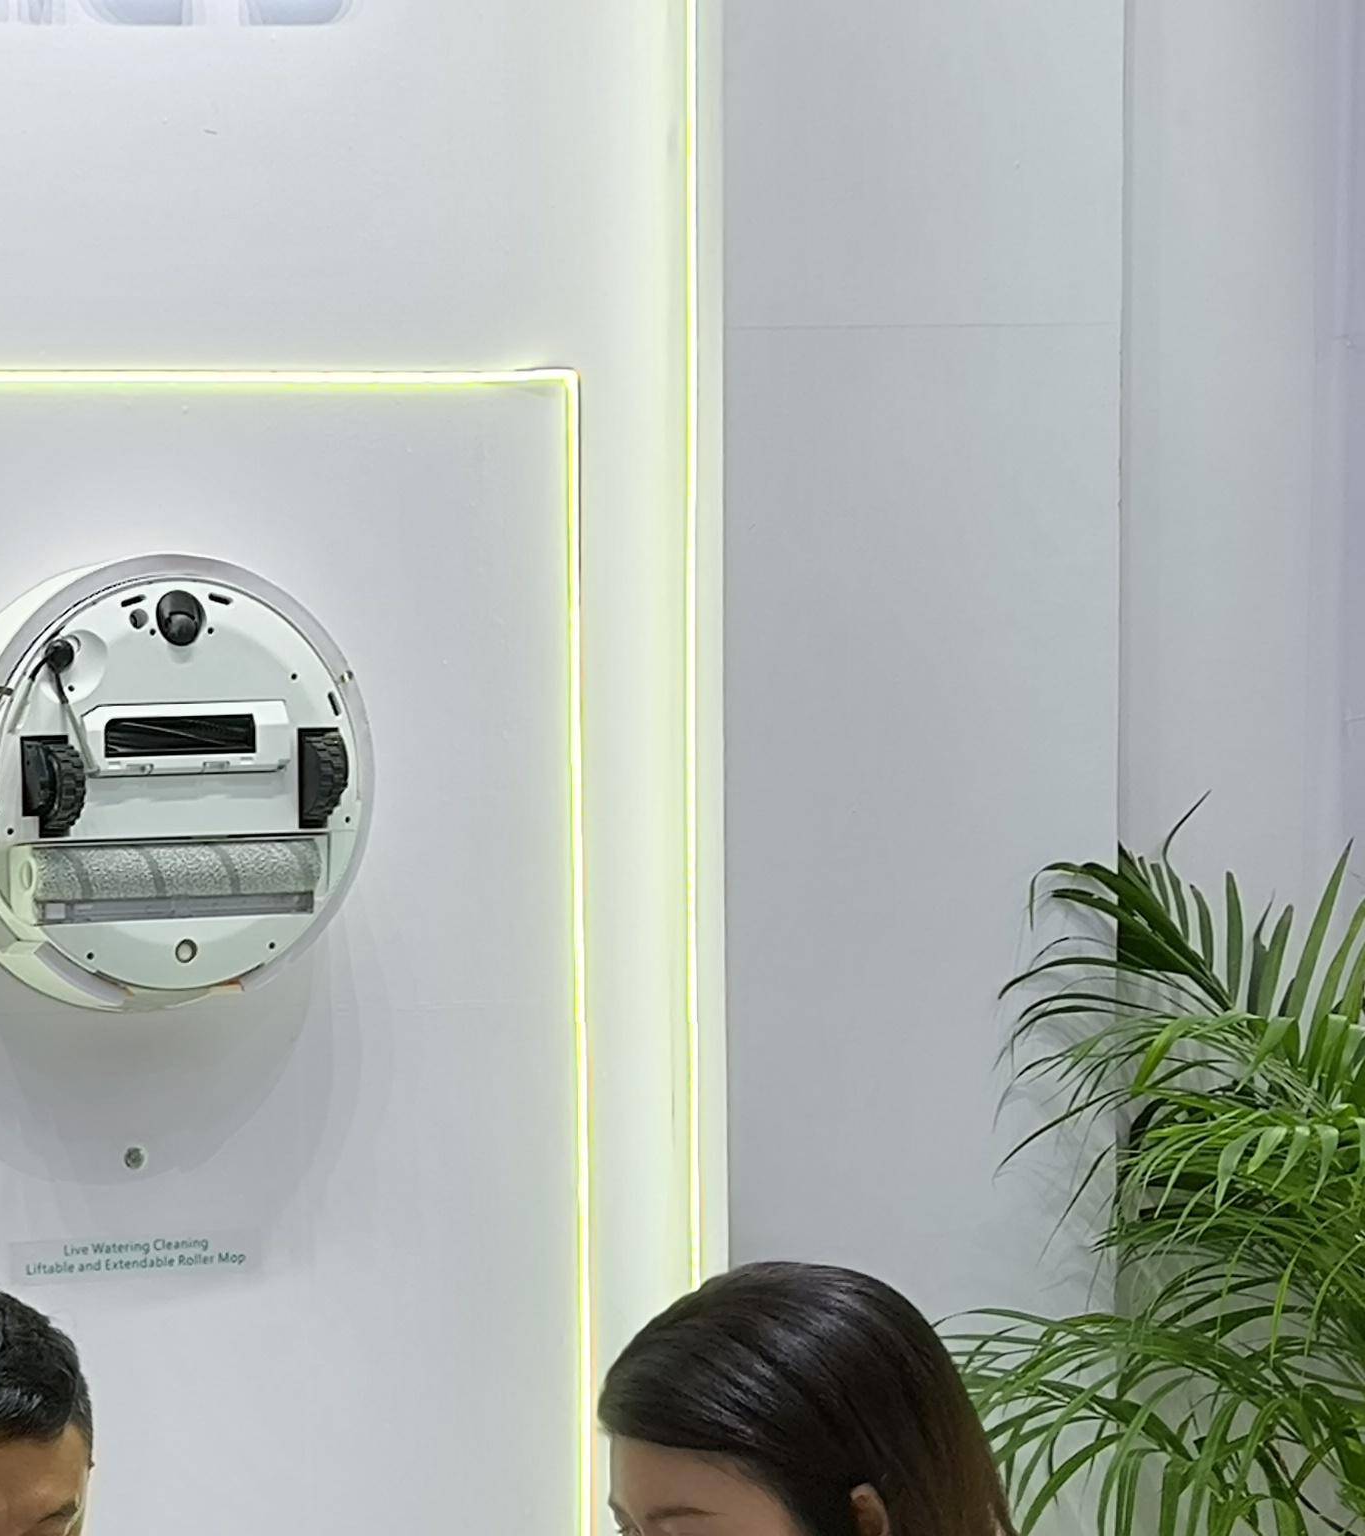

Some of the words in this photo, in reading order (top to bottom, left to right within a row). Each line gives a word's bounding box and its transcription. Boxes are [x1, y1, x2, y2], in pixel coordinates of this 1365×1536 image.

[63, 1244, 89, 1257] Live
[91, 1241, 150, 1255] Watering
[153, 1238, 209, 1252] Cleaning
[25, 1261, 75, 1276] Liftable
[77, 1259, 101, 1273] and
[105, 1255, 175, 1272] Extendable
[177, 1253, 214, 1267] Roller
[218, 1251, 246, 1266] Mop
